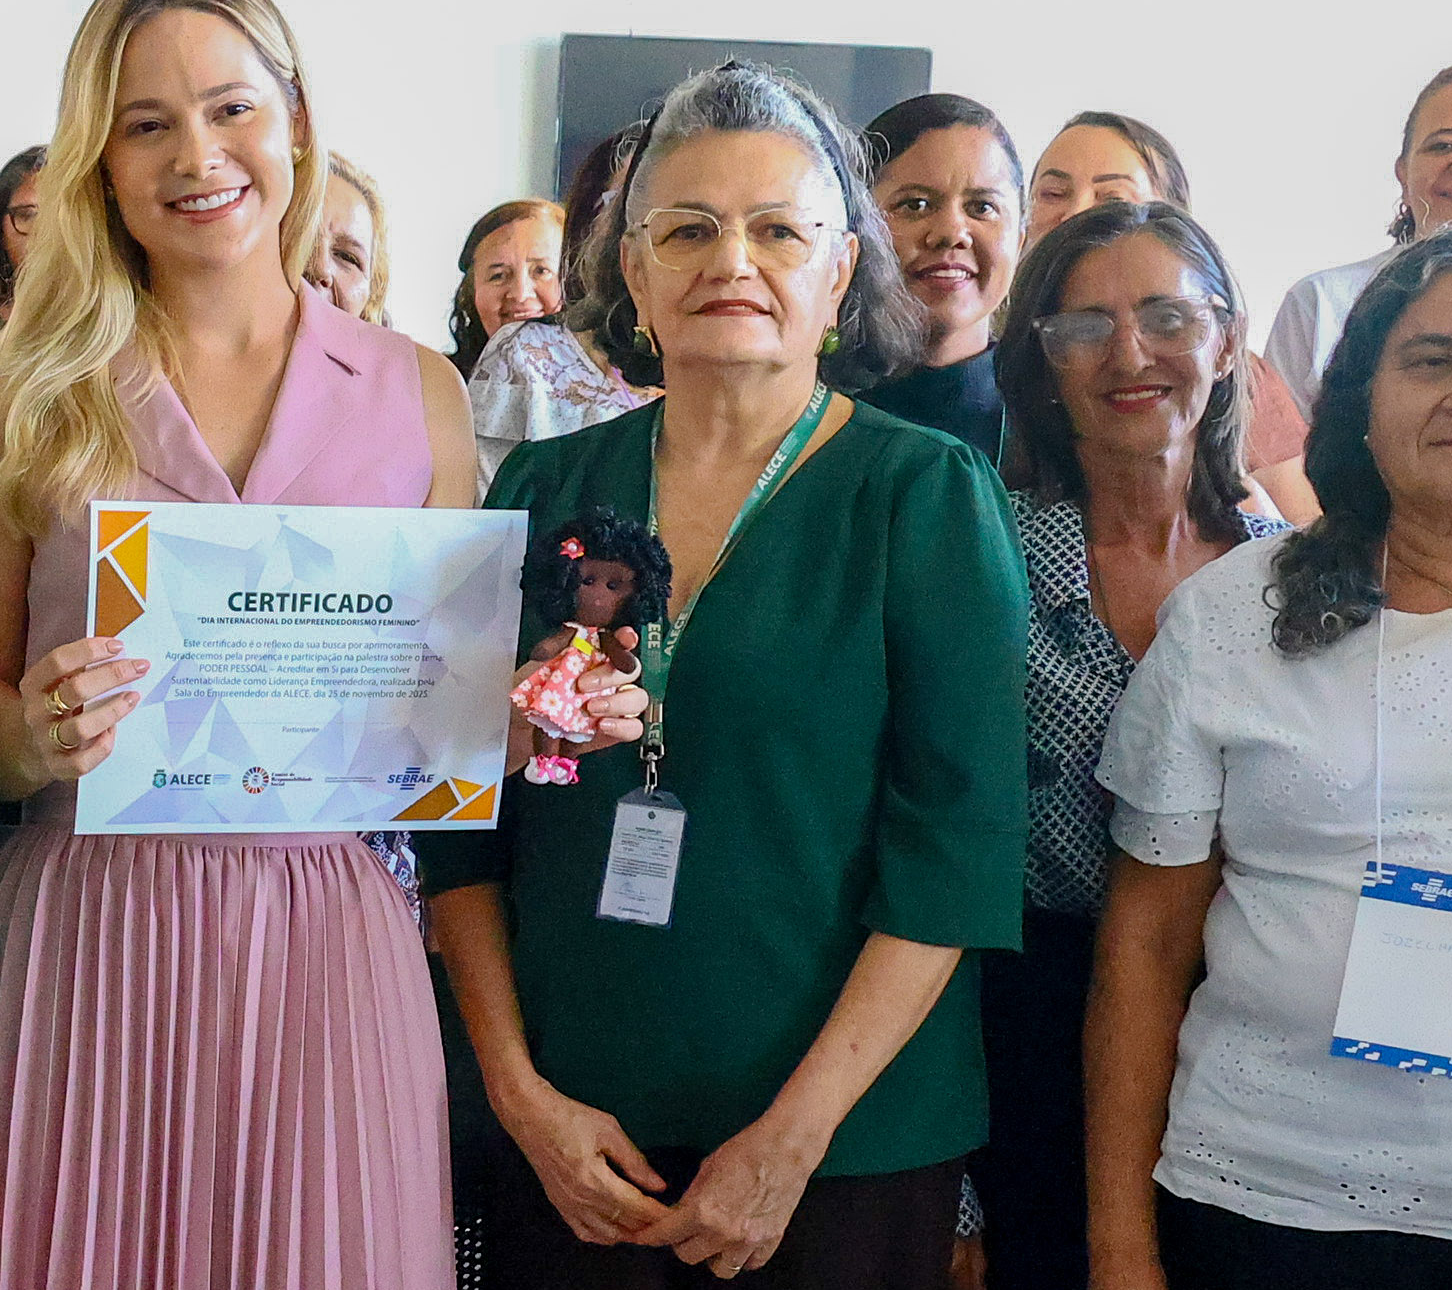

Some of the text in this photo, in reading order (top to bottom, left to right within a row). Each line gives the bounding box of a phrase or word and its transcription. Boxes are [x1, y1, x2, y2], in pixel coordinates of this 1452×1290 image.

[757, 450, 788, 490] ALECE
[227, 591, 394, 614] CERTIFICADO
[216, 617, 279, 625] INTERNACIONAL
[281, 617, 293, 625] DO
[294, 618, 377, 626] EMPREENDEDORISMO
[183, 638, 201, 648] Este
[202, 639, 247, 649] certificado
[249, 639, 255, 649] é
[256, 641, 262, 649] o
[263, 639, 292, 649] reflexo
[293, 639, 304, 649] da
[306, 642, 321, 650] sua
[322, 640, 346, 650] busca
[348, 642, 363, 652] por
[165, 651, 223, 662] Agradecemos
[225, 651, 244, 663] pela
[245, 653, 283, 663] presença
[290, 652, 343, 664] participação
[344, 654, 355, 662] na
[356, 652, 389, 664] palestra
[390, 652, 413, 662] sobre
[414, 654, 421, 662] o
[199, 664, 229, 673] PODER
[230, 664, 268, 674] PESSOAL
[276, 665, 314, 674] Acreditar
[315, 666, 330, 674] em
[340, 666, 359, 676] para
[360, 665, 411, 675] Desenvolver
[171, 676, 242, 686] Sustentabilidade
[243, 678, 267, 686] como
[268, 676, 309, 688] Liderança
[380, 678, 416, 687] realizada
[417, 678, 435, 689] pela
[174, 688, 192, 697] Sala
[194, 688, 205, 697] do
[207, 689, 269, 699] Empreendedor
[270, 689, 281, 698] da
[313, 689, 326, 698] dia
[328, 690, 339, 698] 25
[340, 690, 350, 698] de
[352, 690, 394, 699] novembro
[395, 690, 407, 699] de
[281, 725, 320, 734] Participante
[169, 773, 212, 786] ALECE
[386, 774, 435, 784] SEBRAE
